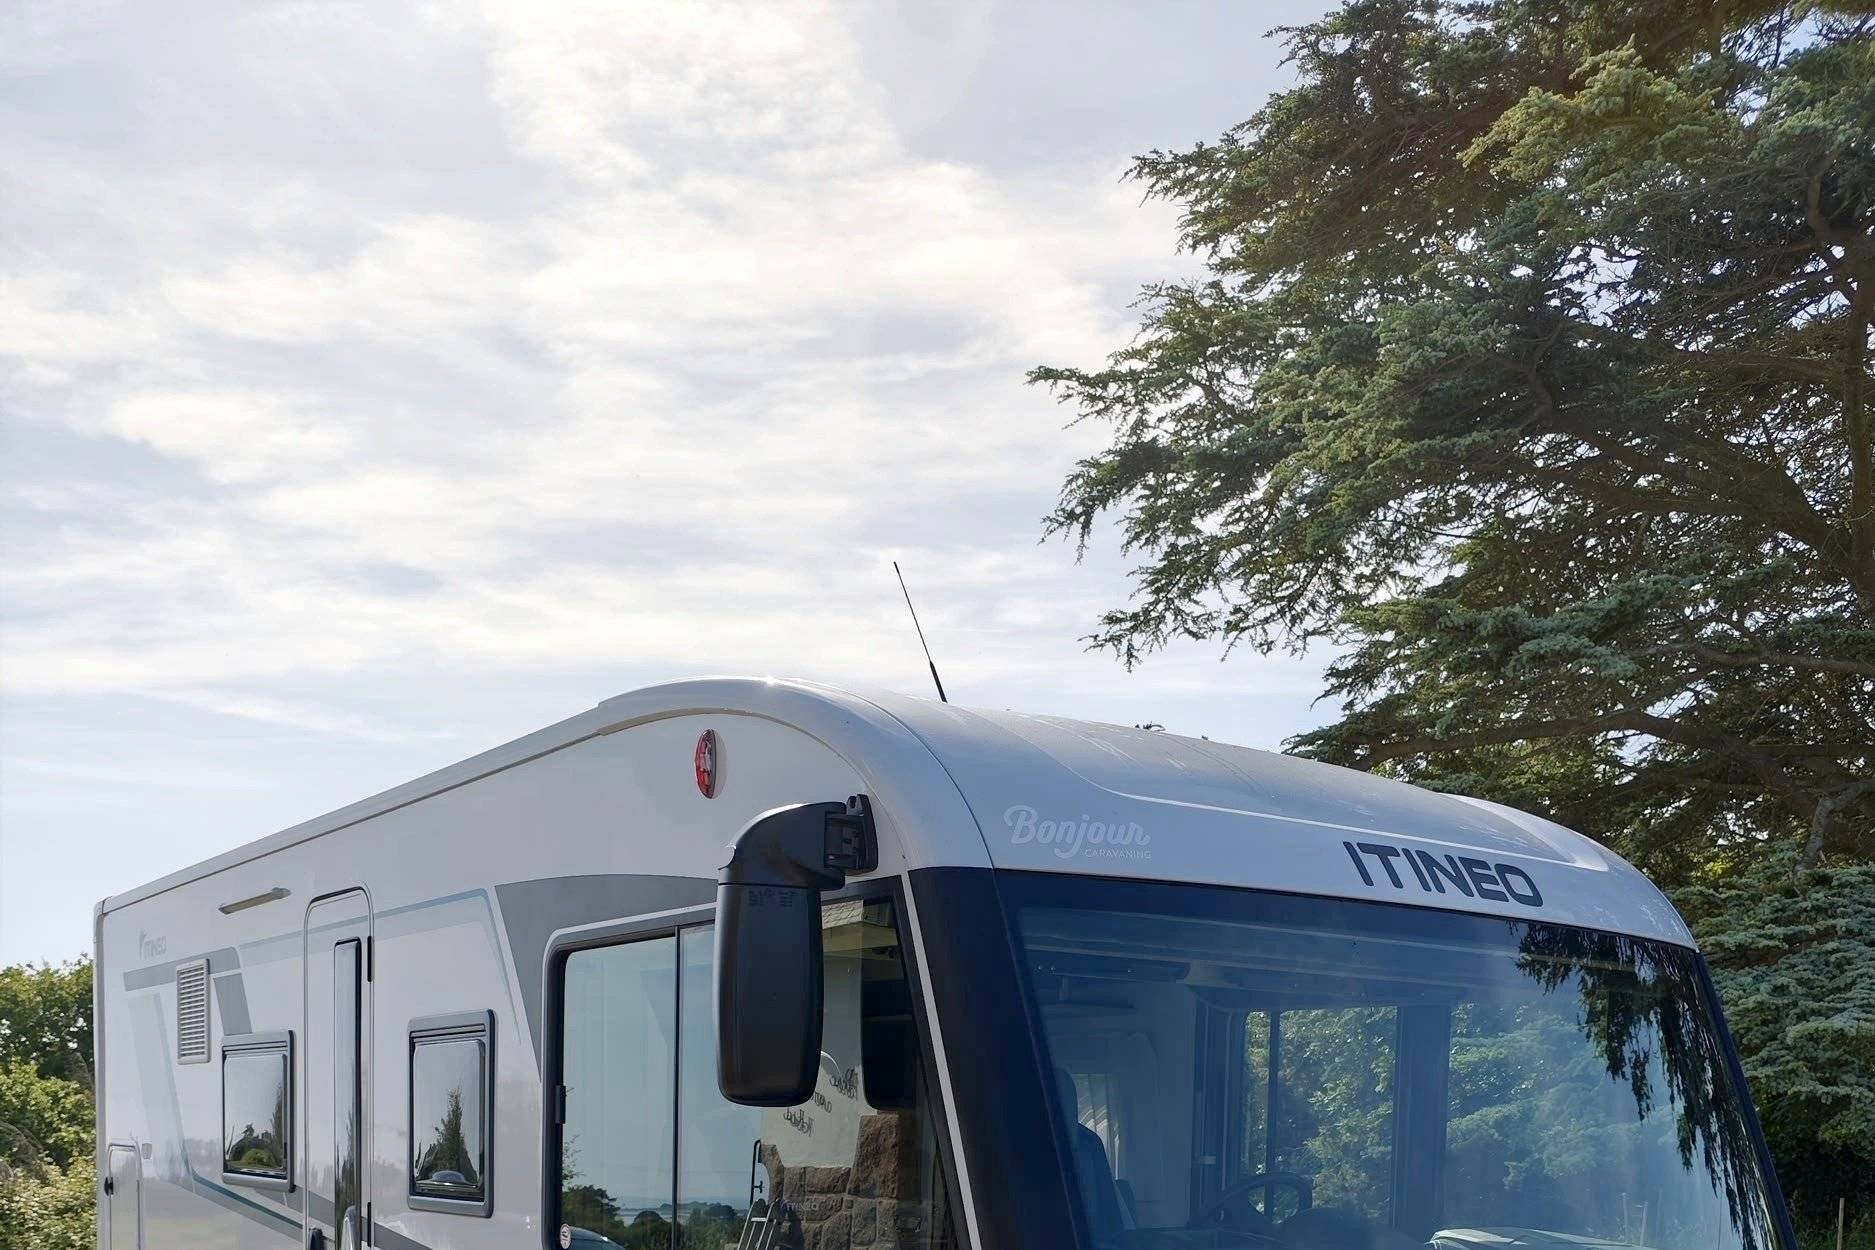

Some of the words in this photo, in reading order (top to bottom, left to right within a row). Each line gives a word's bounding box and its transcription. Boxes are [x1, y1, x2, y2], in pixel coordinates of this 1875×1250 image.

[1003, 804, 1151, 859] Bonjour
[1084, 849, 1152, 859] CARAVANING
[1343, 841, 1544, 907] ITINEO
